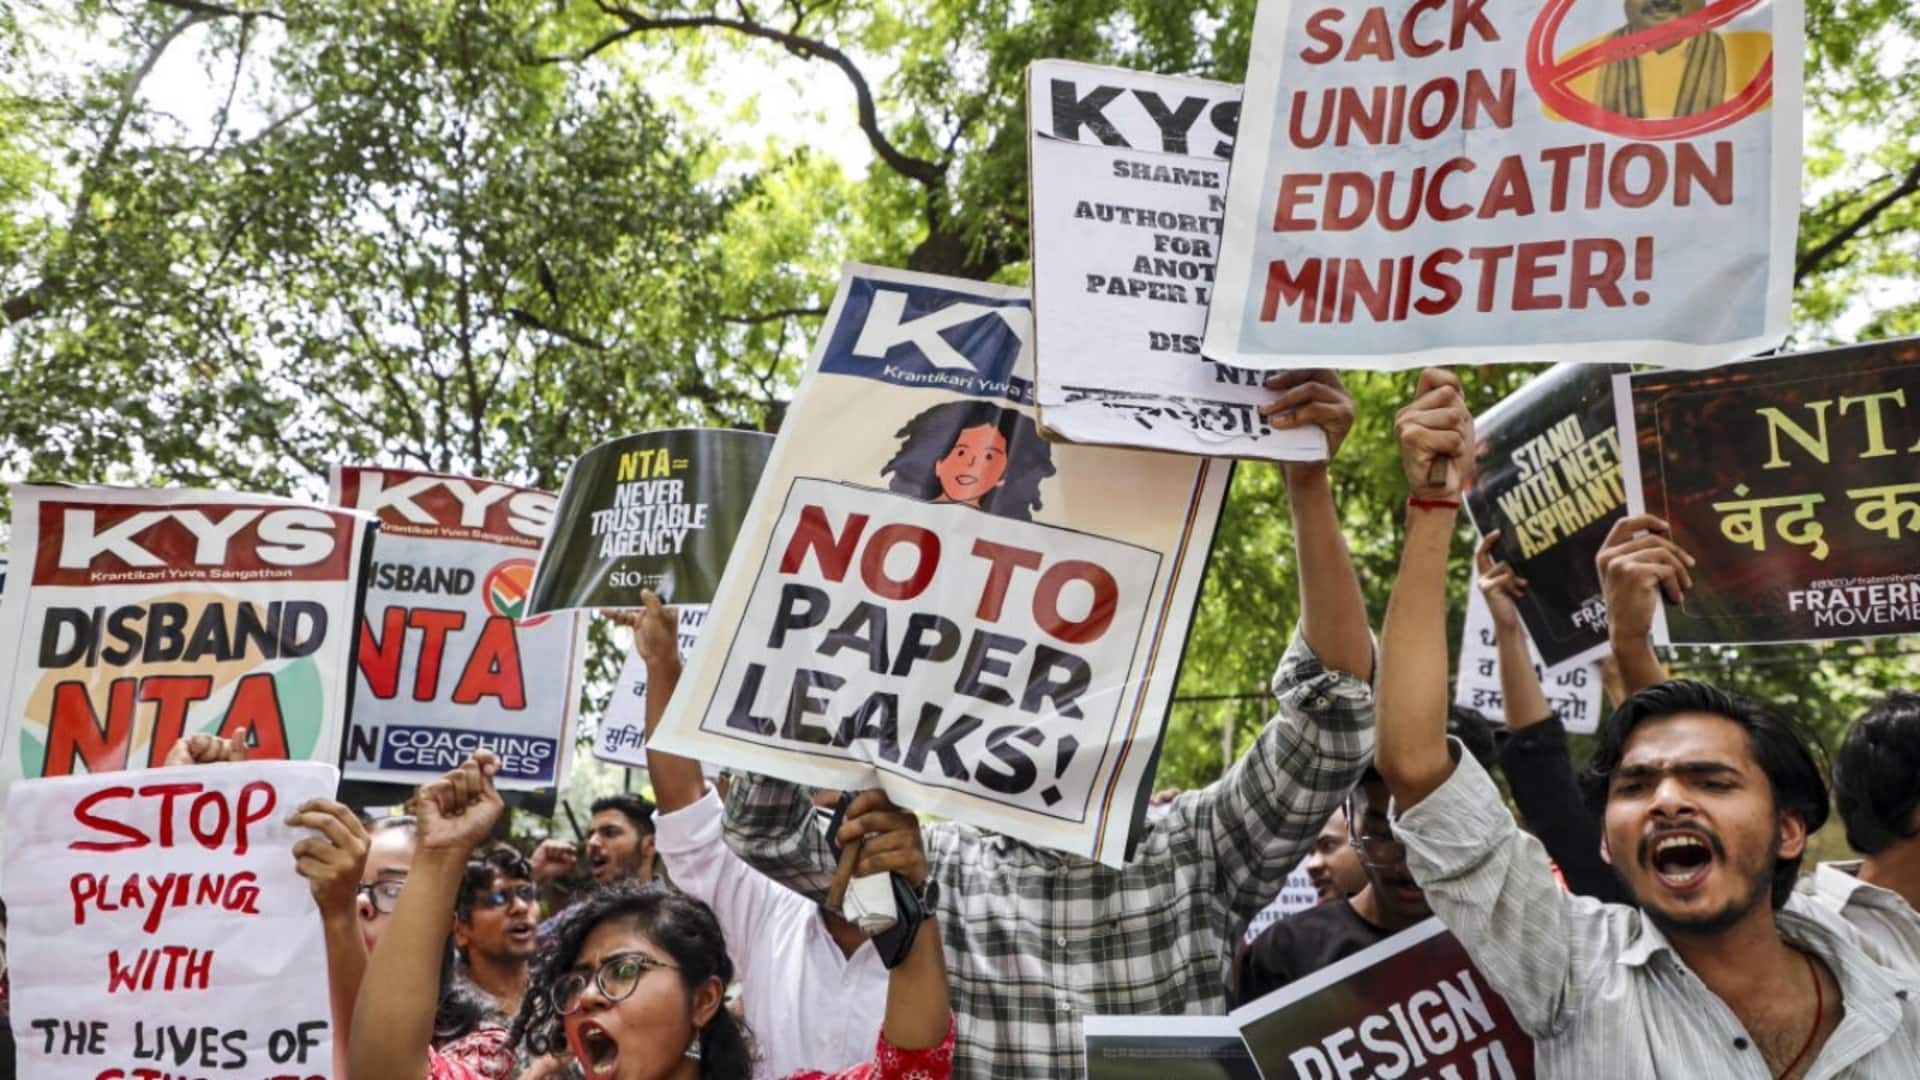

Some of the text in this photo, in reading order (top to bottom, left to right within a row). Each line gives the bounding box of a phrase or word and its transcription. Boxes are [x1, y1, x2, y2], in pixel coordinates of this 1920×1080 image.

[1300, 0, 1501, 64] SACK
[1288, 68, 1516, 150] UNION
[1113, 160, 1220, 189] SHAME
[1273, 141, 1733, 233] EDUCATION
[1153, 233, 1212, 258] FOR
[1086, 273, 1188, 304] PAPER
[1260, 236, 1654, 324] MINISTER!
[883, 365, 973, 389] Krantikari
[978, 379, 1020, 397] Yuva
[1511, 413, 1585, 484] STAND
[1755, 388, 1920, 469] NT
[357, 471, 558, 539] KYS
[613, 479, 684, 508] NEVER
[1497, 426, 1623, 526] WITH NEET
[58, 508, 336, 569] KYS
[590, 503, 708, 536] TRUSTABLE
[599, 528, 688, 558] AGENCY
[1712, 483, 1829, 560] बंद
[90, 568, 294, 583] Krantikari Yuva Sangathan
[779, 504, 1119, 645] NO TO
[38, 601, 328, 668] DISBAND
[358, 606, 527, 711] NTA
[767, 583, 1092, 720] PAPER
[42, 672, 291, 778] NTA
[388, 730, 551, 759] COACHING
[726, 663, 1081, 807] LEAKS!
[393, 747, 540, 775] CENES
[69, 781, 277, 855] STOP
[70, 873, 260, 933] PLAYING
[108, 946, 214, 993] WITH
[31, 1018, 328, 1069] THE LIVES OF
